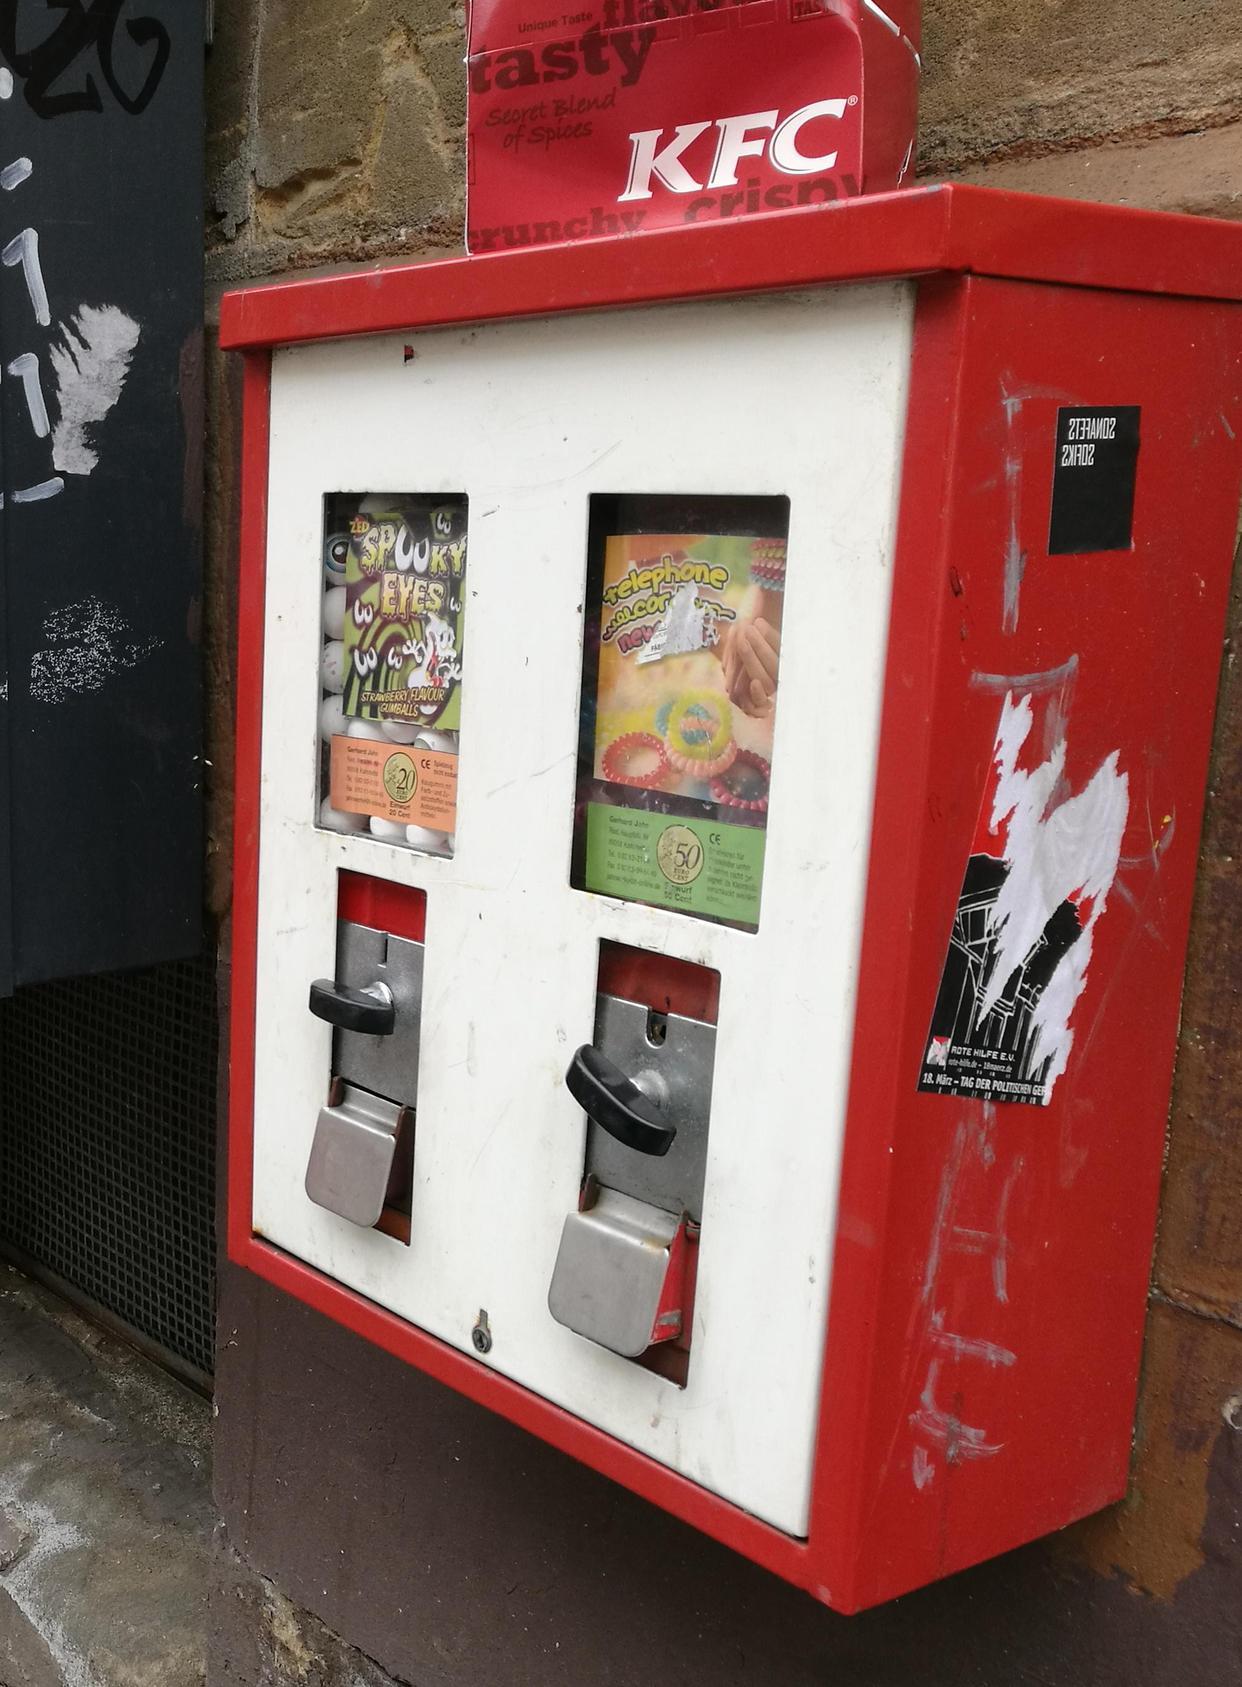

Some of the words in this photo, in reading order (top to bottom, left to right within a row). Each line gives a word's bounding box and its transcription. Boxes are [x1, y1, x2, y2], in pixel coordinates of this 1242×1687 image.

[517, 20, 558, 34] Unique
[562, 12, 594, 27] Taste
[469, 22, 657, 94] tasty
[485, 102, 547, 127] Secret
[554, 87, 617, 118] Blend
[503, 125, 526, 153] of
[528, 120, 593, 150] Spices
[617, 98, 848, 202] KFC
[350, 520, 370, 535] ZED
[602, 555, 730, 606] telephone
[381, 572, 447, 622] EYES
[361, 688, 409, 704] STRAWBERRY
[409, 686, 445, 702] FLAVOUR
[379, 702, 419, 717] GUMBALLS
[396, 768, 416, 791] 20
[673, 843, 701, 870] 50
[674, 893, 693, 904] Cent
[951, 1046, 972, 1056] ROTE
[973, 1049, 999, 1060] HILFE
[922, 1072, 934, 1084] 18.
[935, 1073, 953, 1086] März
[960, 1076, 975, 1089] TAG
[975, 1078, 991, 1091] DER
[992, 1080, 1033, 1095] POLITISCHEN
